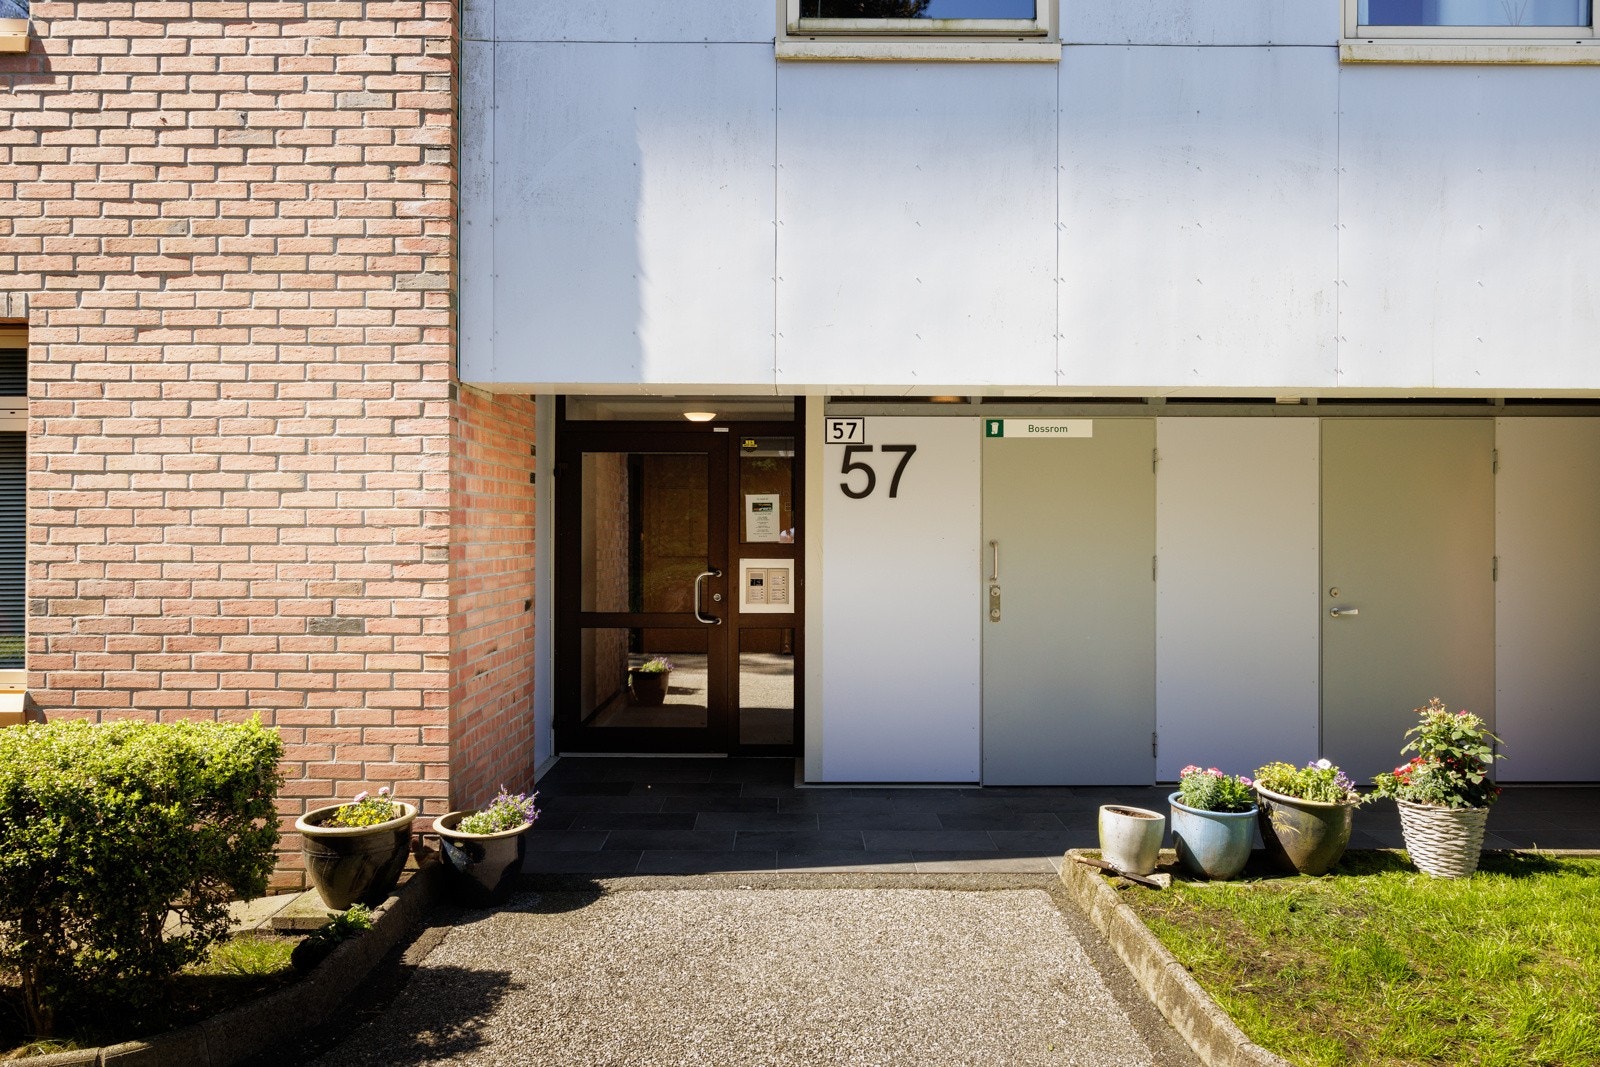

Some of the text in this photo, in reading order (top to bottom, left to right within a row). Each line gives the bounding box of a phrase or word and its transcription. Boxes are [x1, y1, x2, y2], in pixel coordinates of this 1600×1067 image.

[833, 422, 857, 439] 57
[1028, 424, 1068, 433] Bossrom
[840, 444, 917, 499] 57
